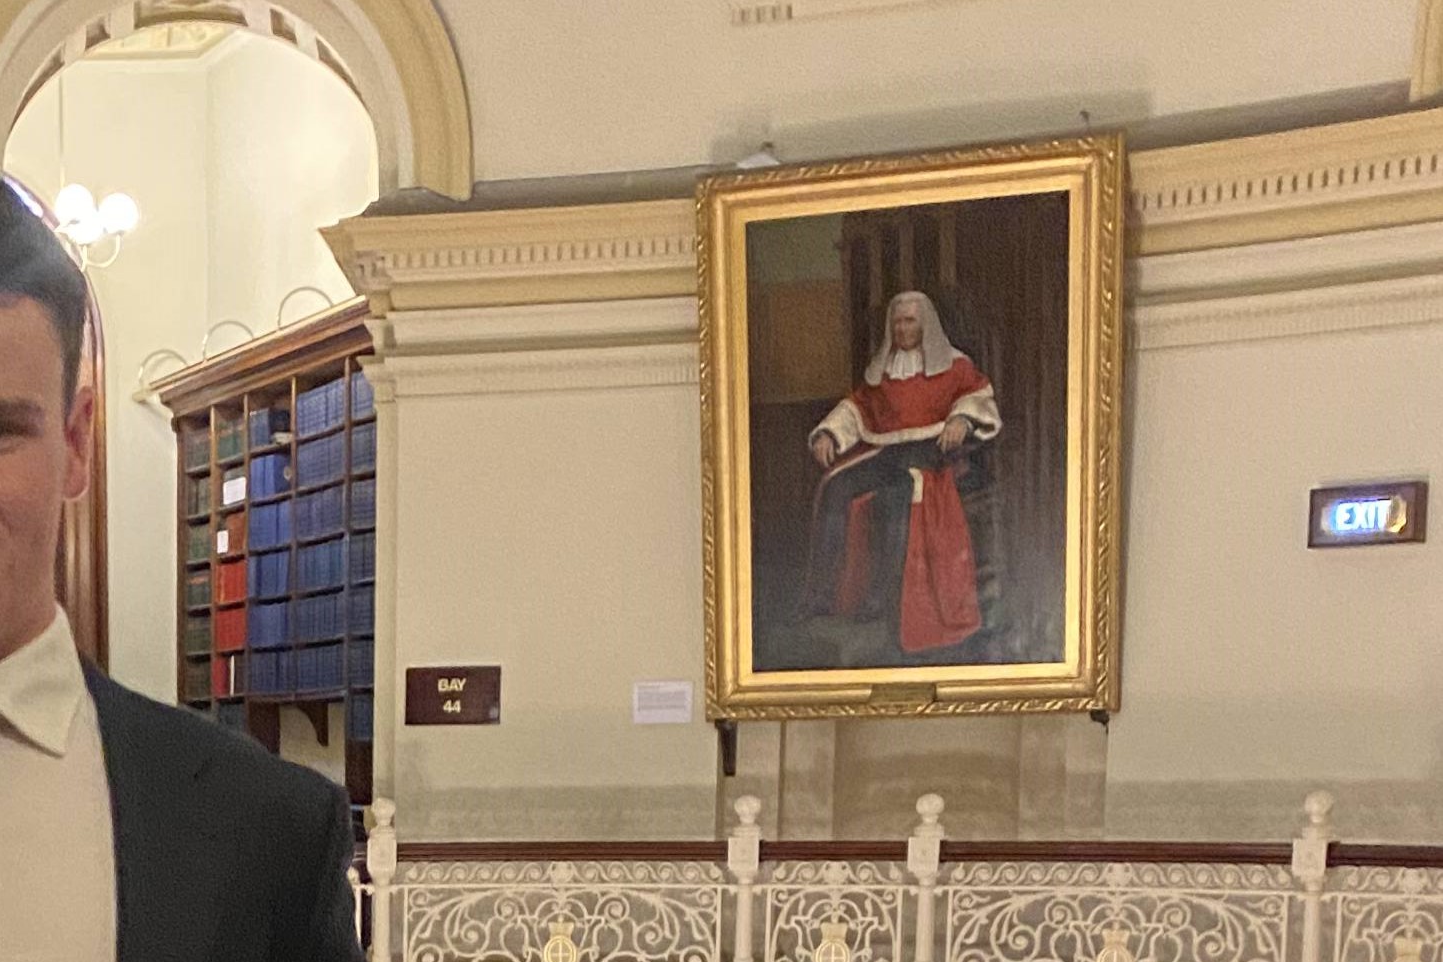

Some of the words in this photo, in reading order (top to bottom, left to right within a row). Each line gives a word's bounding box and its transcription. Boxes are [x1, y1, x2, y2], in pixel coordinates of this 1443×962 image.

[1335, 500, 1392, 531] EXIT
[437, 677, 467, 692] BAY
[442, 699, 462, 713] 44
